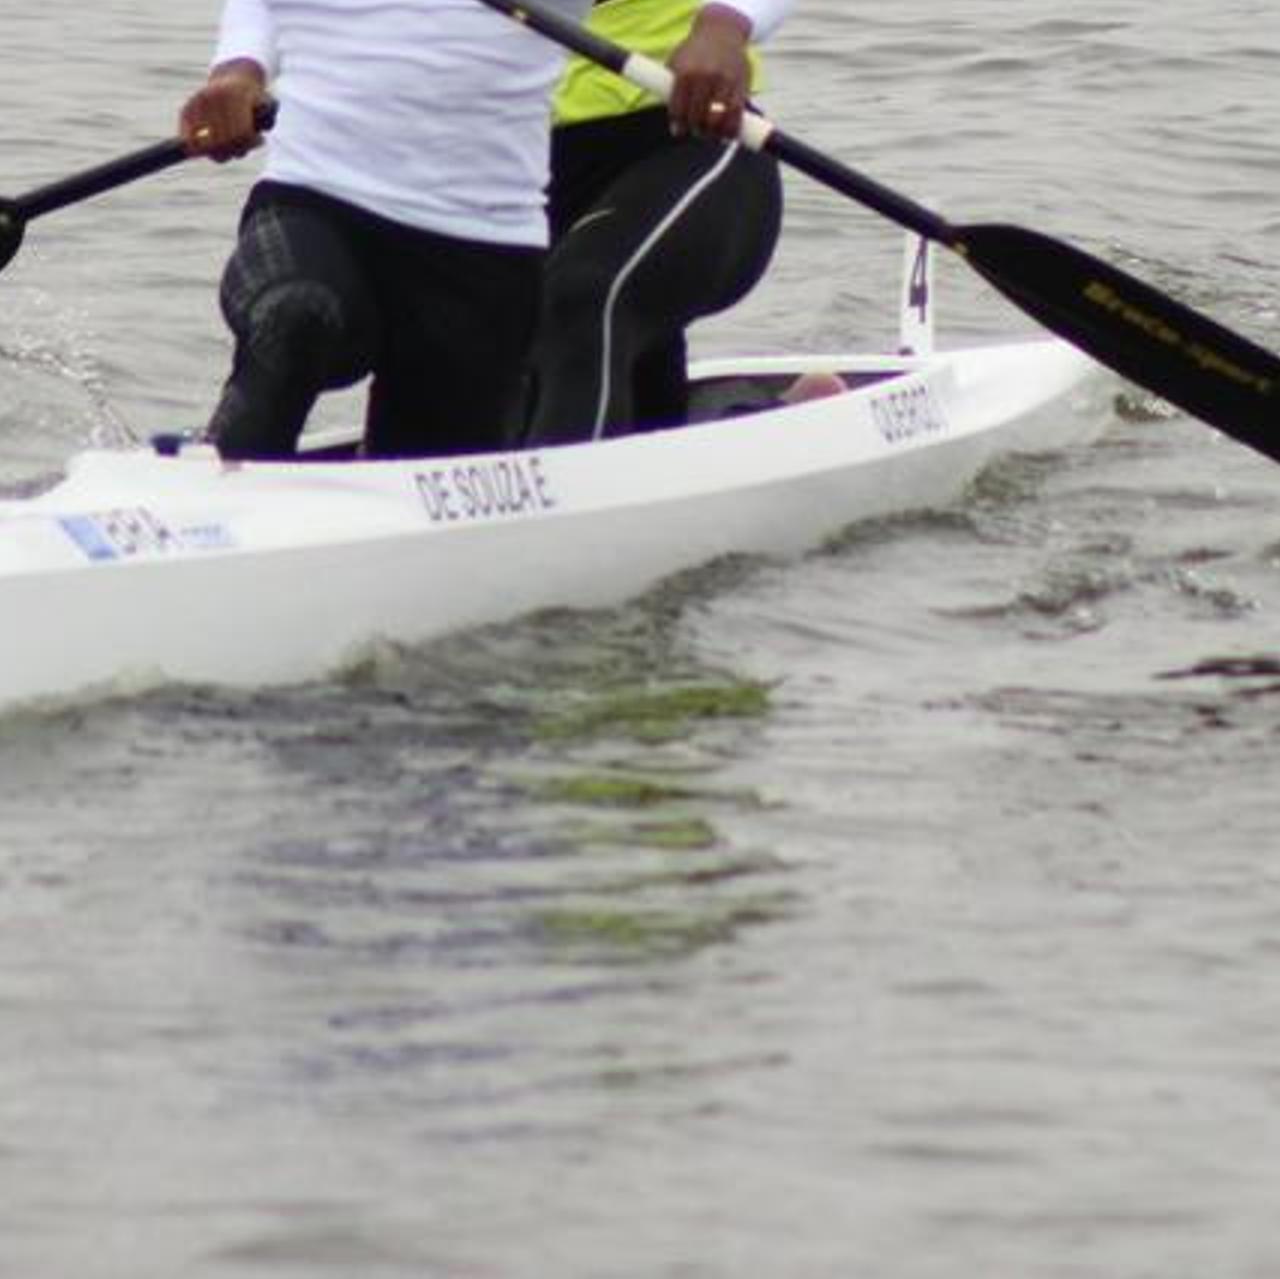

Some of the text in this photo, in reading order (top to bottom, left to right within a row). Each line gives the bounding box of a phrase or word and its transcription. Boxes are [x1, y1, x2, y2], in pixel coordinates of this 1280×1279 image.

[908, 235, 930, 325] 4
[415, 472, 462, 521] DE
[454, 460, 535, 518] SOUZA
